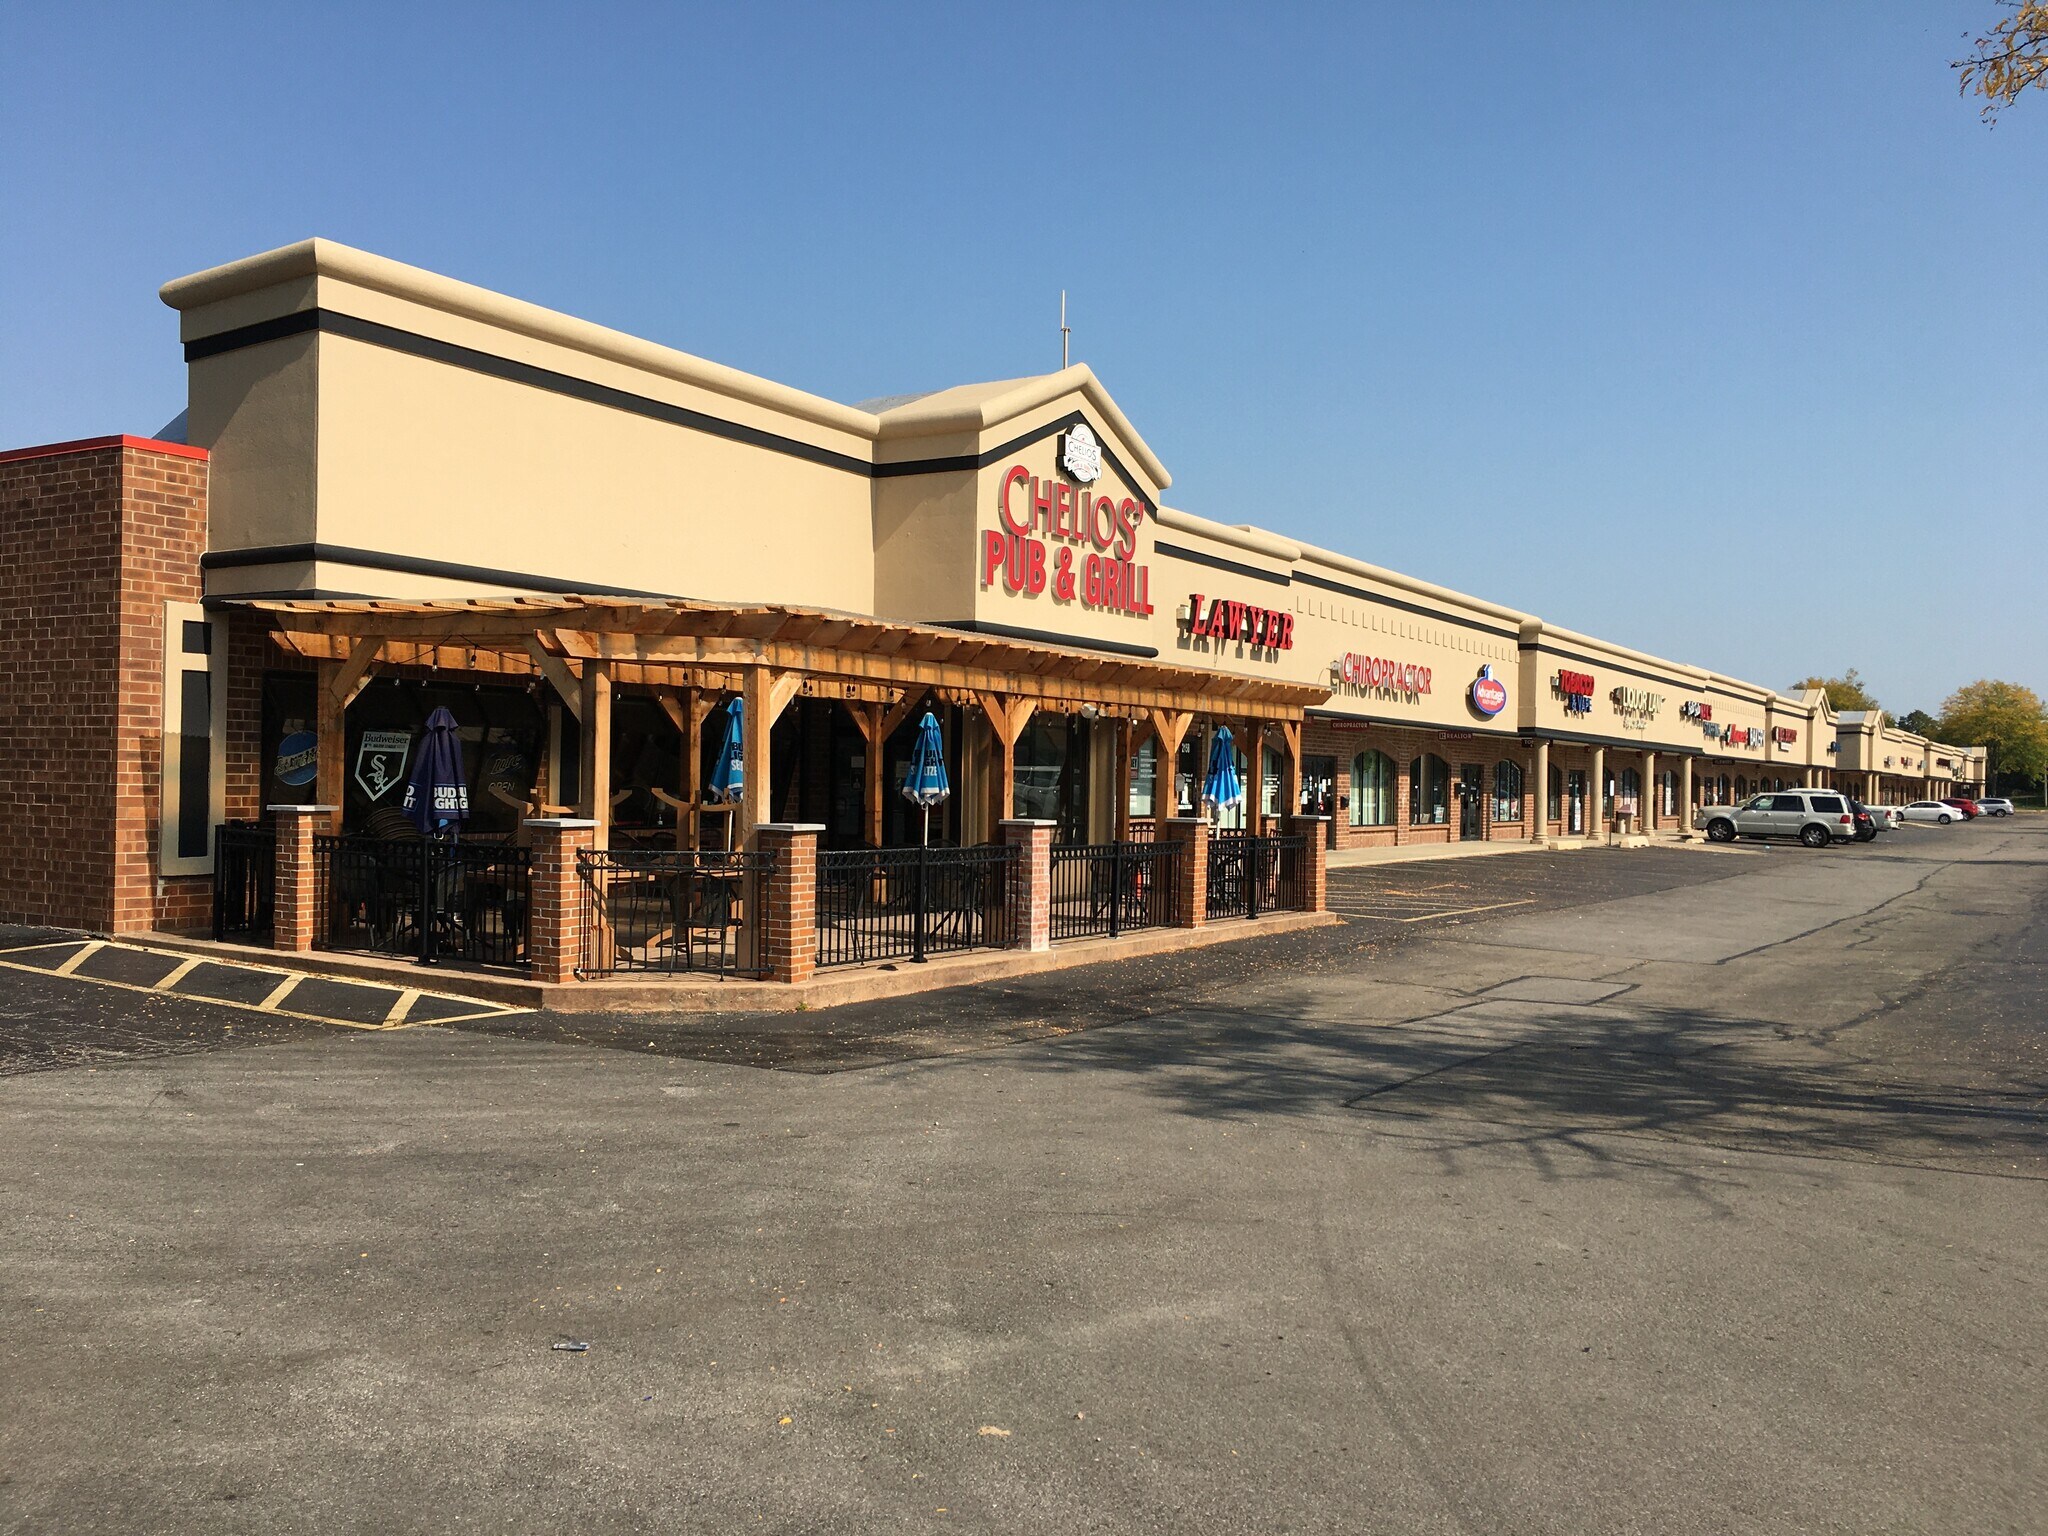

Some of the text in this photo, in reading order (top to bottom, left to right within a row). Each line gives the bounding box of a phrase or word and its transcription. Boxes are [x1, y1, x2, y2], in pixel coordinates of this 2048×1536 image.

[1068, 440, 1097, 461] CHELIOS
[999, 465, 1145, 562] CHELIOS'
[981, 529, 1154, 615] PUB & GRILL
[1188, 594, 1295, 650] LAWYER
[1342, 652, 1432, 694] CHIROPRACTOR
[1559, 669, 1595, 697] TOBACCO
[1622, 687, 1647, 710] LIQUOR
[364, 733, 409, 744] Budweiser
[434, 798, 459, 810] GHT
